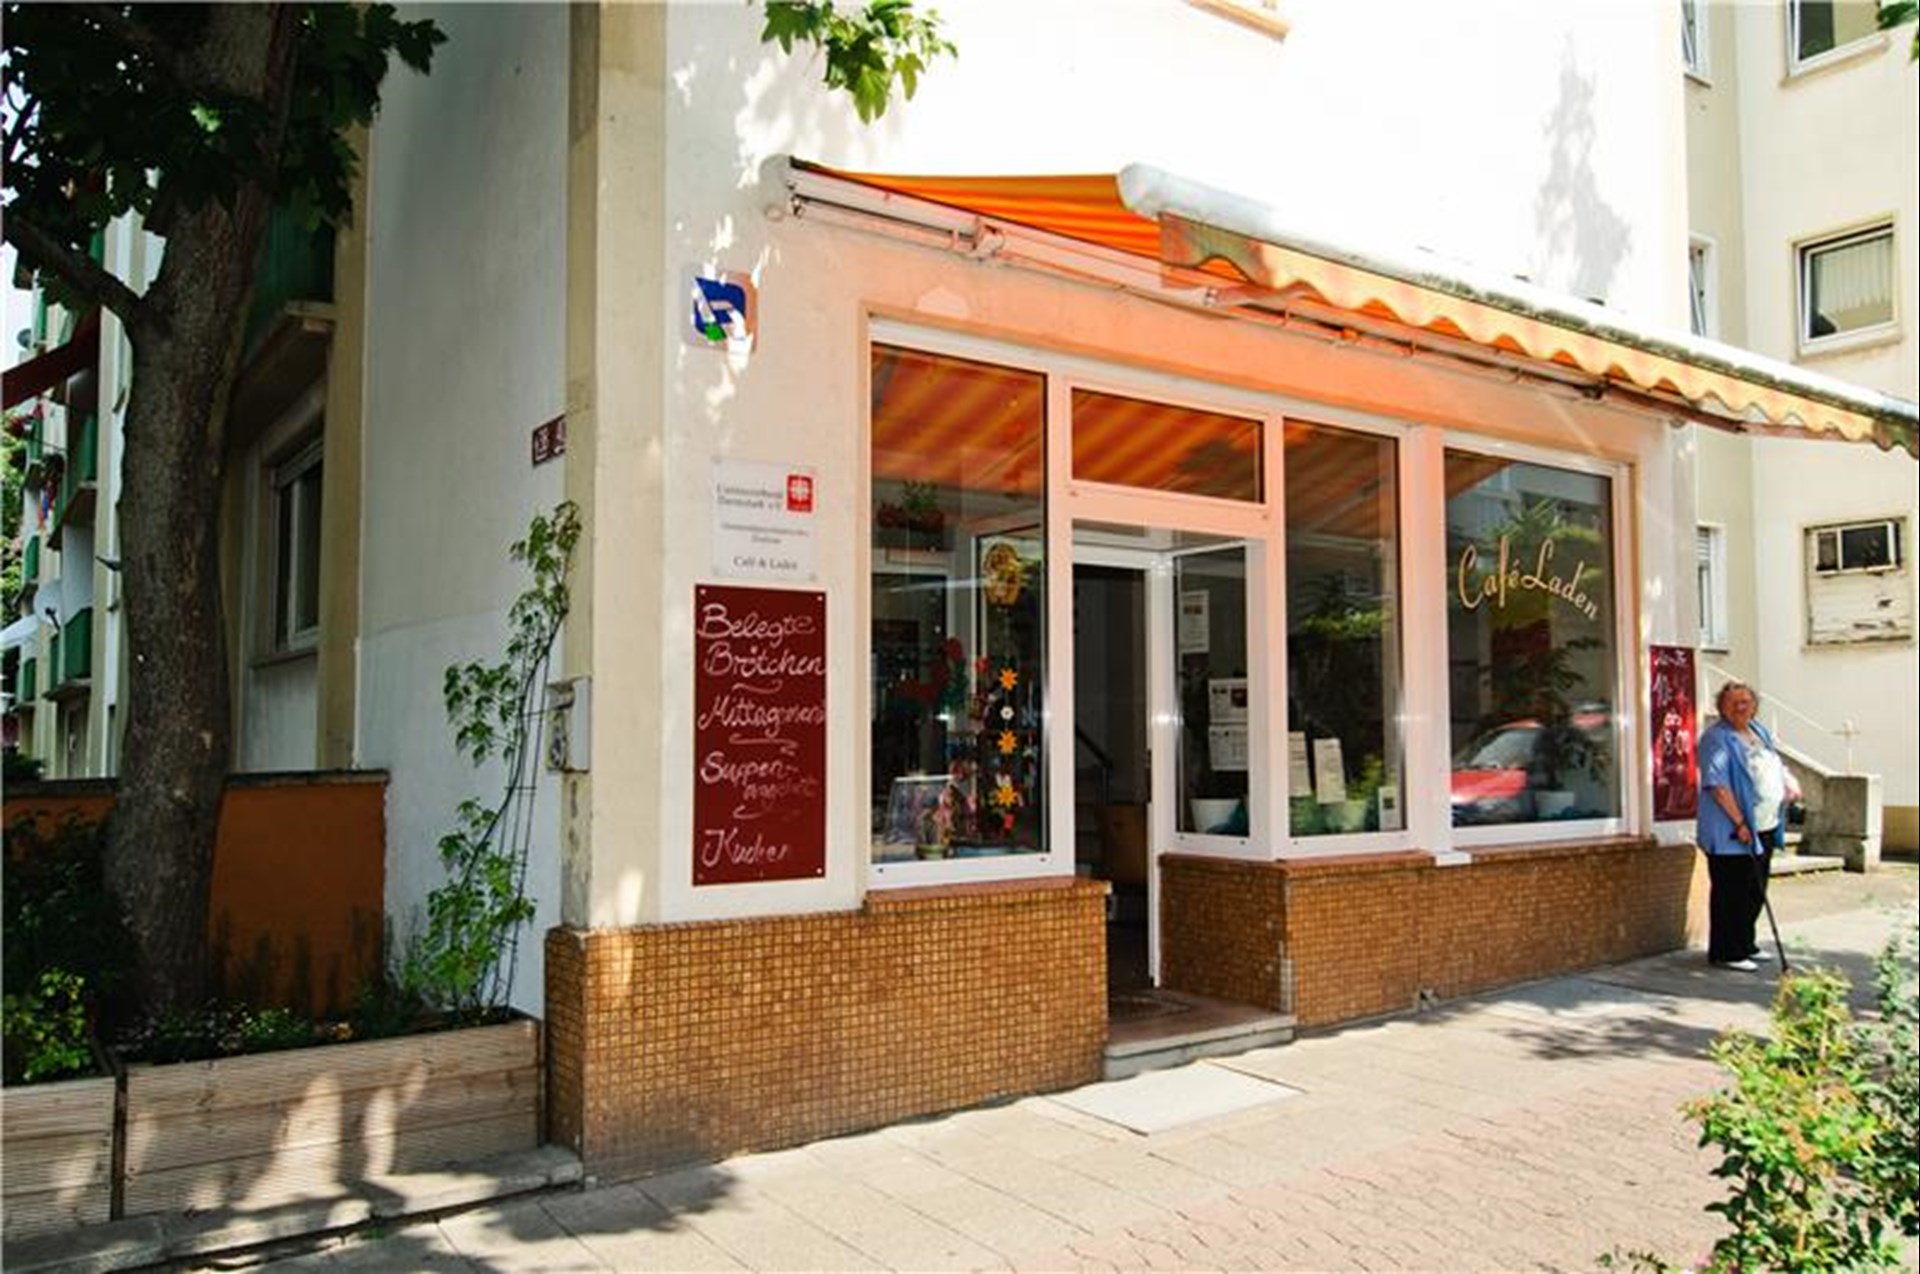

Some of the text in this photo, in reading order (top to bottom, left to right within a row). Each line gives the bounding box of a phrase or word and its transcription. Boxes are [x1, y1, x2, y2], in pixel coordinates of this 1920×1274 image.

[1458, 534, 1600, 621] Café Laden
[697, 602, 817, 648] Belegte
[704, 640, 826, 679] Brötchen
